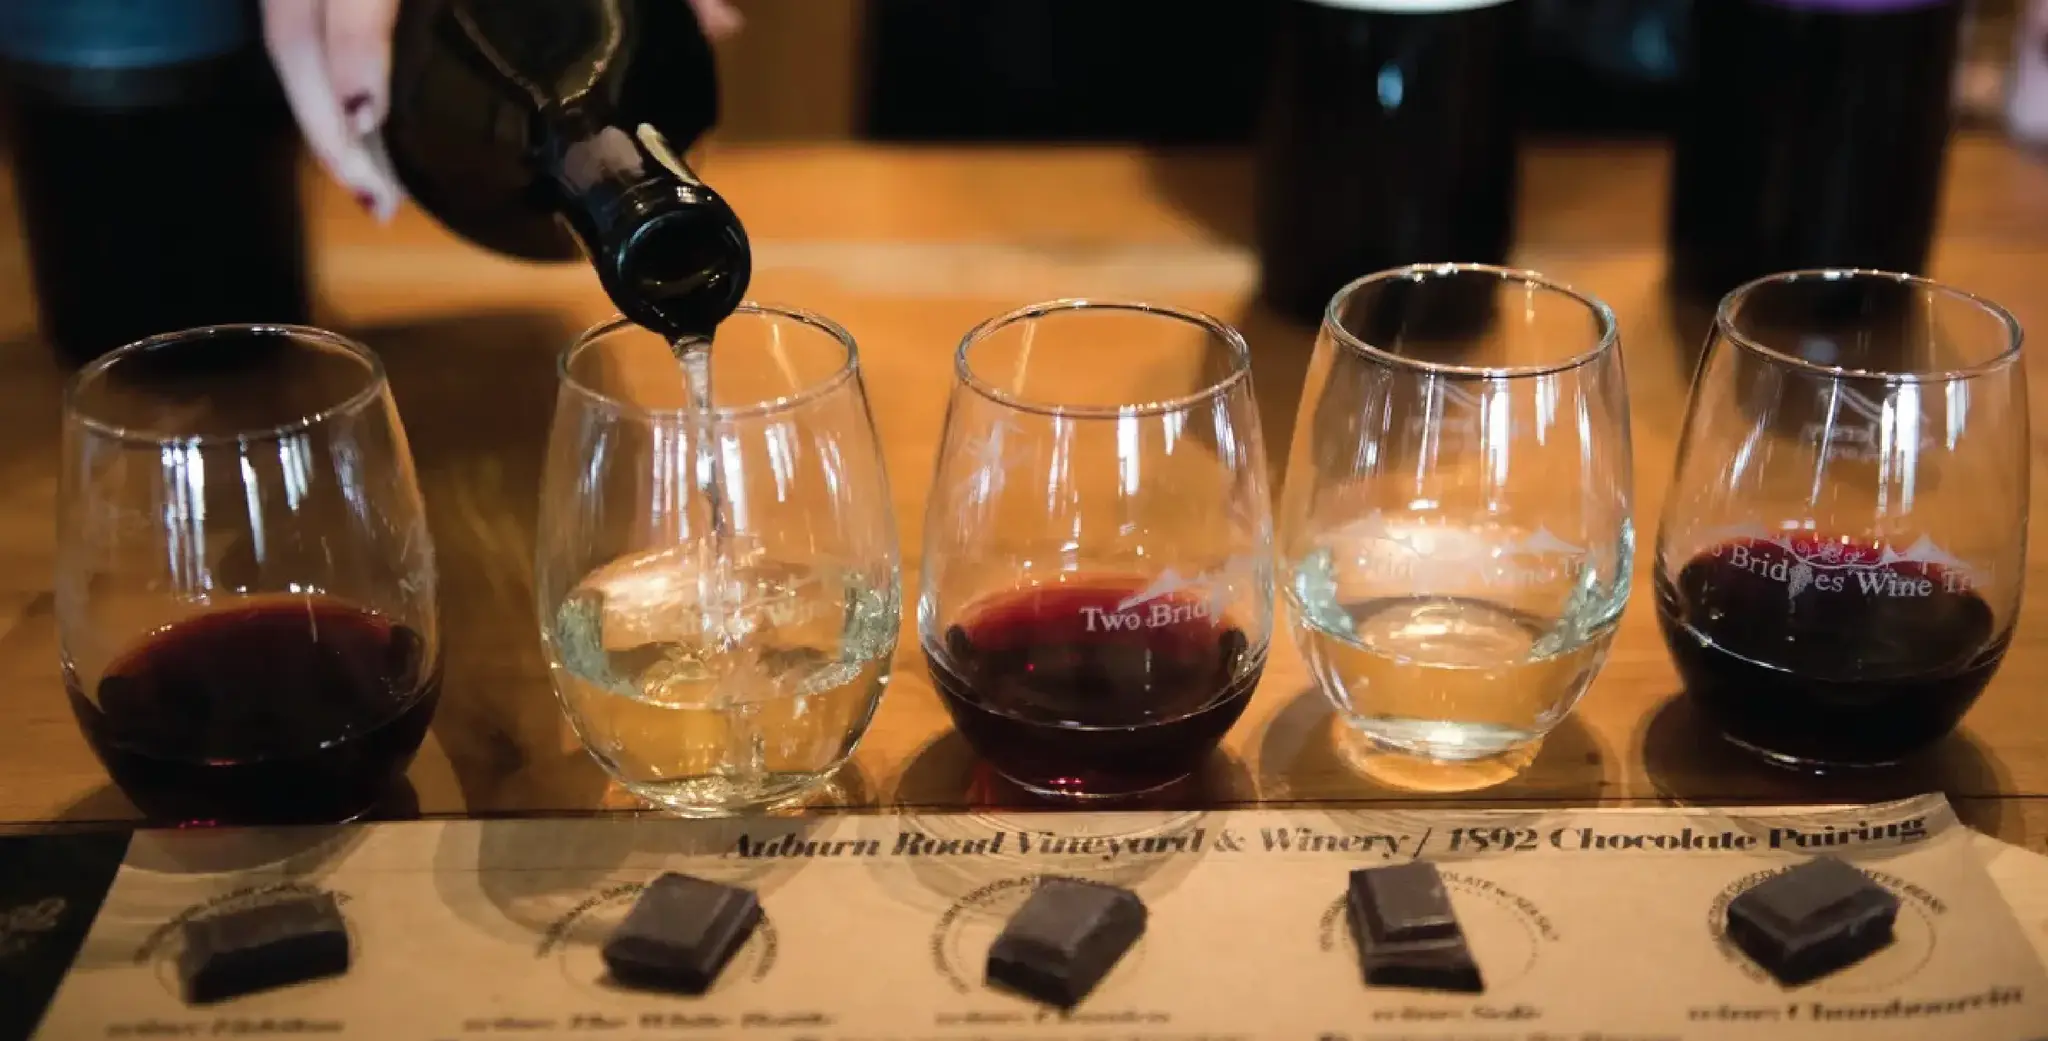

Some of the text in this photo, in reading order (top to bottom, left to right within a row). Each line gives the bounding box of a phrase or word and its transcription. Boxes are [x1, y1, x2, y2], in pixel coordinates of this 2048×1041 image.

[1857, 569, 1933, 597] Wine
[1079, 606, 1141, 631] Two
[722, 832, 881, 858] Auburn
[891, 831, 1005, 856] Road
[1018, 827, 1205, 861] Vineyard
[1213, 831, 1246, 852] &
[1260, 827, 1410, 860] Winery
[1449, 827, 1540, 852] 1892
[1550, 826, 1757, 851] Chocolate
[1769, 814, 1928, 851] Pairing
